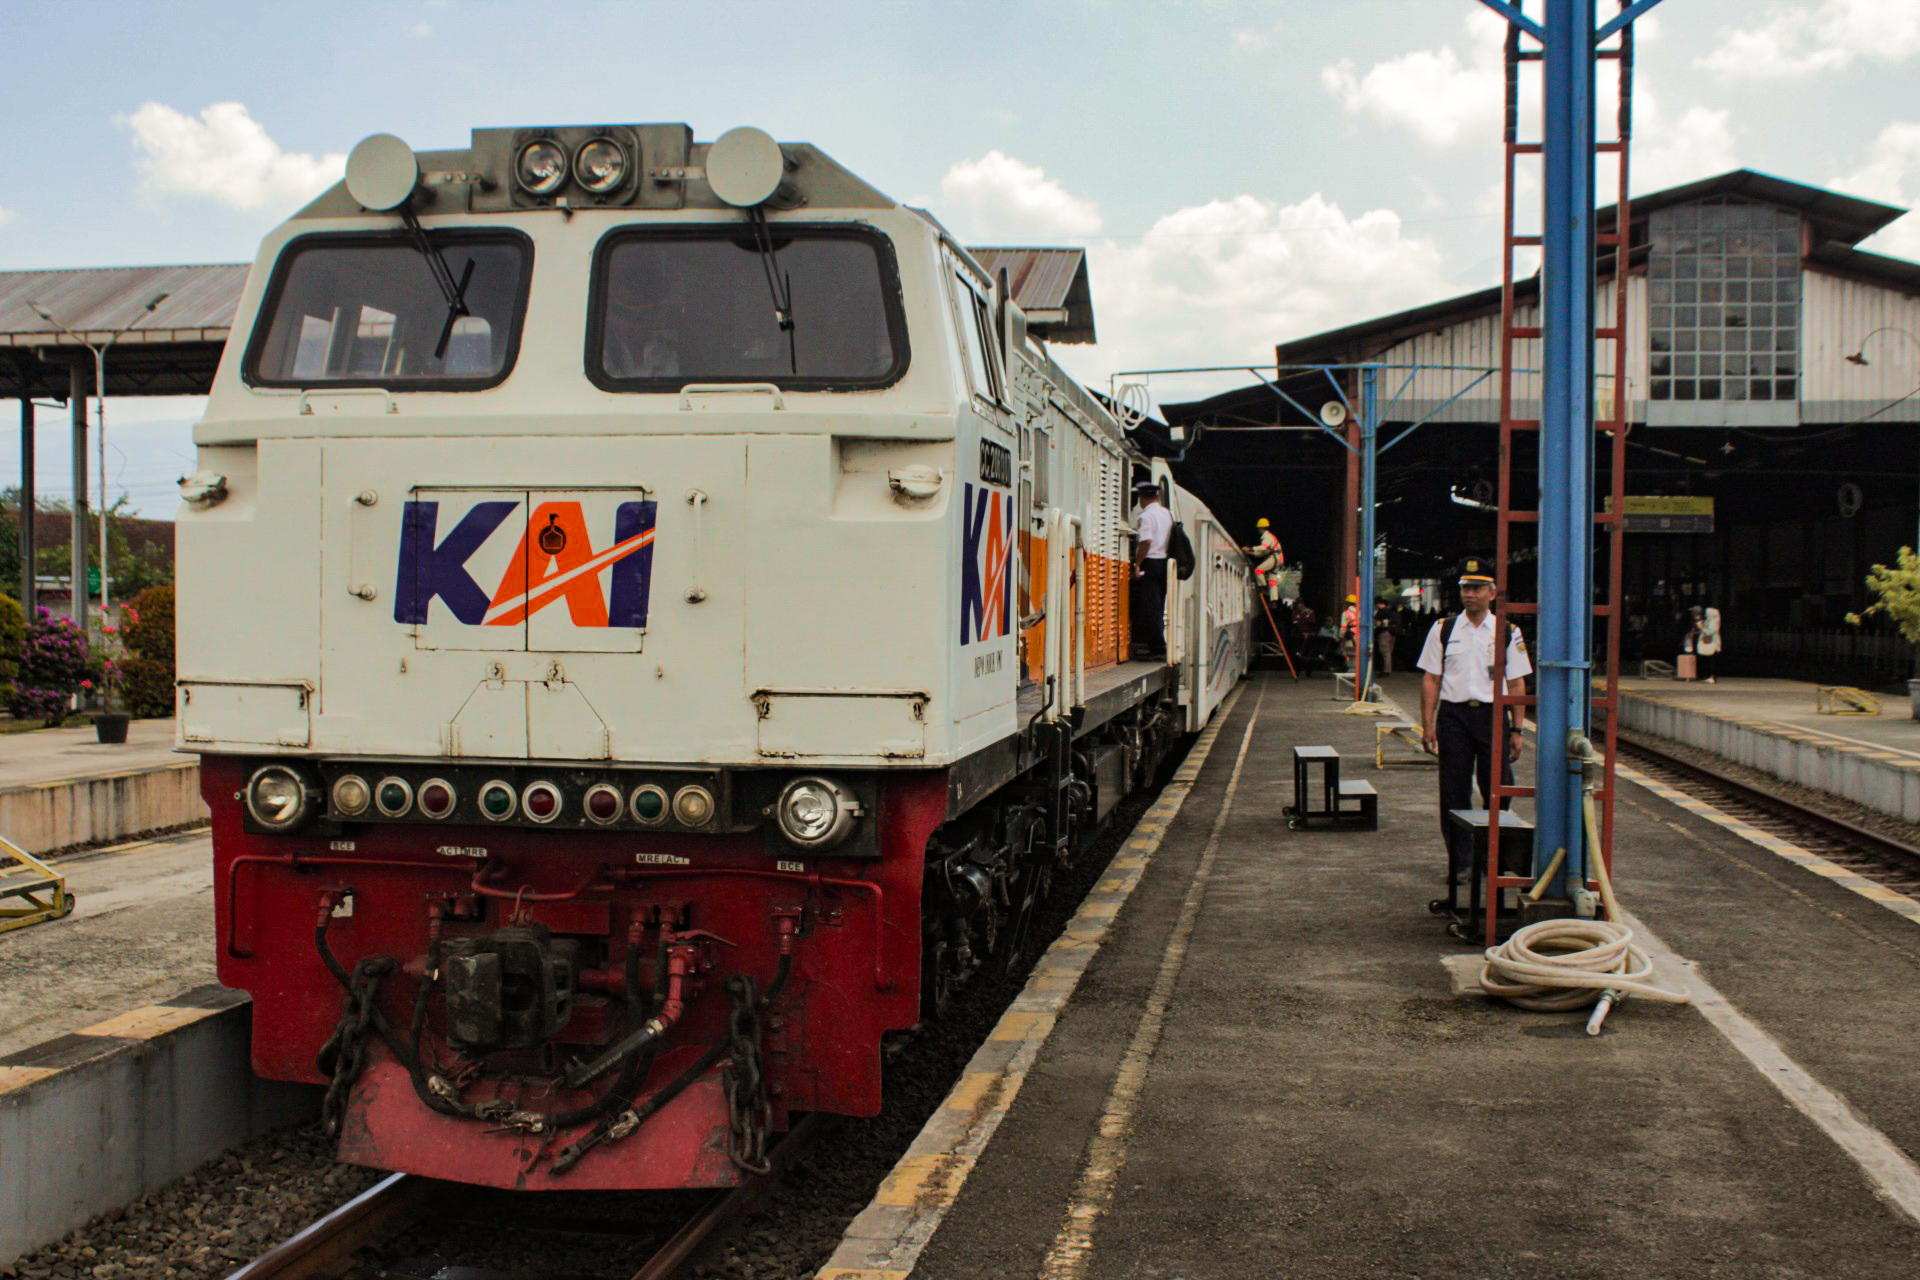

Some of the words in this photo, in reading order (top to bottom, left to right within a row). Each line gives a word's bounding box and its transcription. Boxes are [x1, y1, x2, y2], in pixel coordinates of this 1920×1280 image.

[393, 501, 657, 628] KAI
[960, 482, 1013, 646] KAI
[440, 846, 459, 856] ACT
[463, 848, 485, 857] MRE
[638, 854, 660, 863] MRE
[666, 855, 688, 864] ACT
[780, 862, 802, 871] BCE
